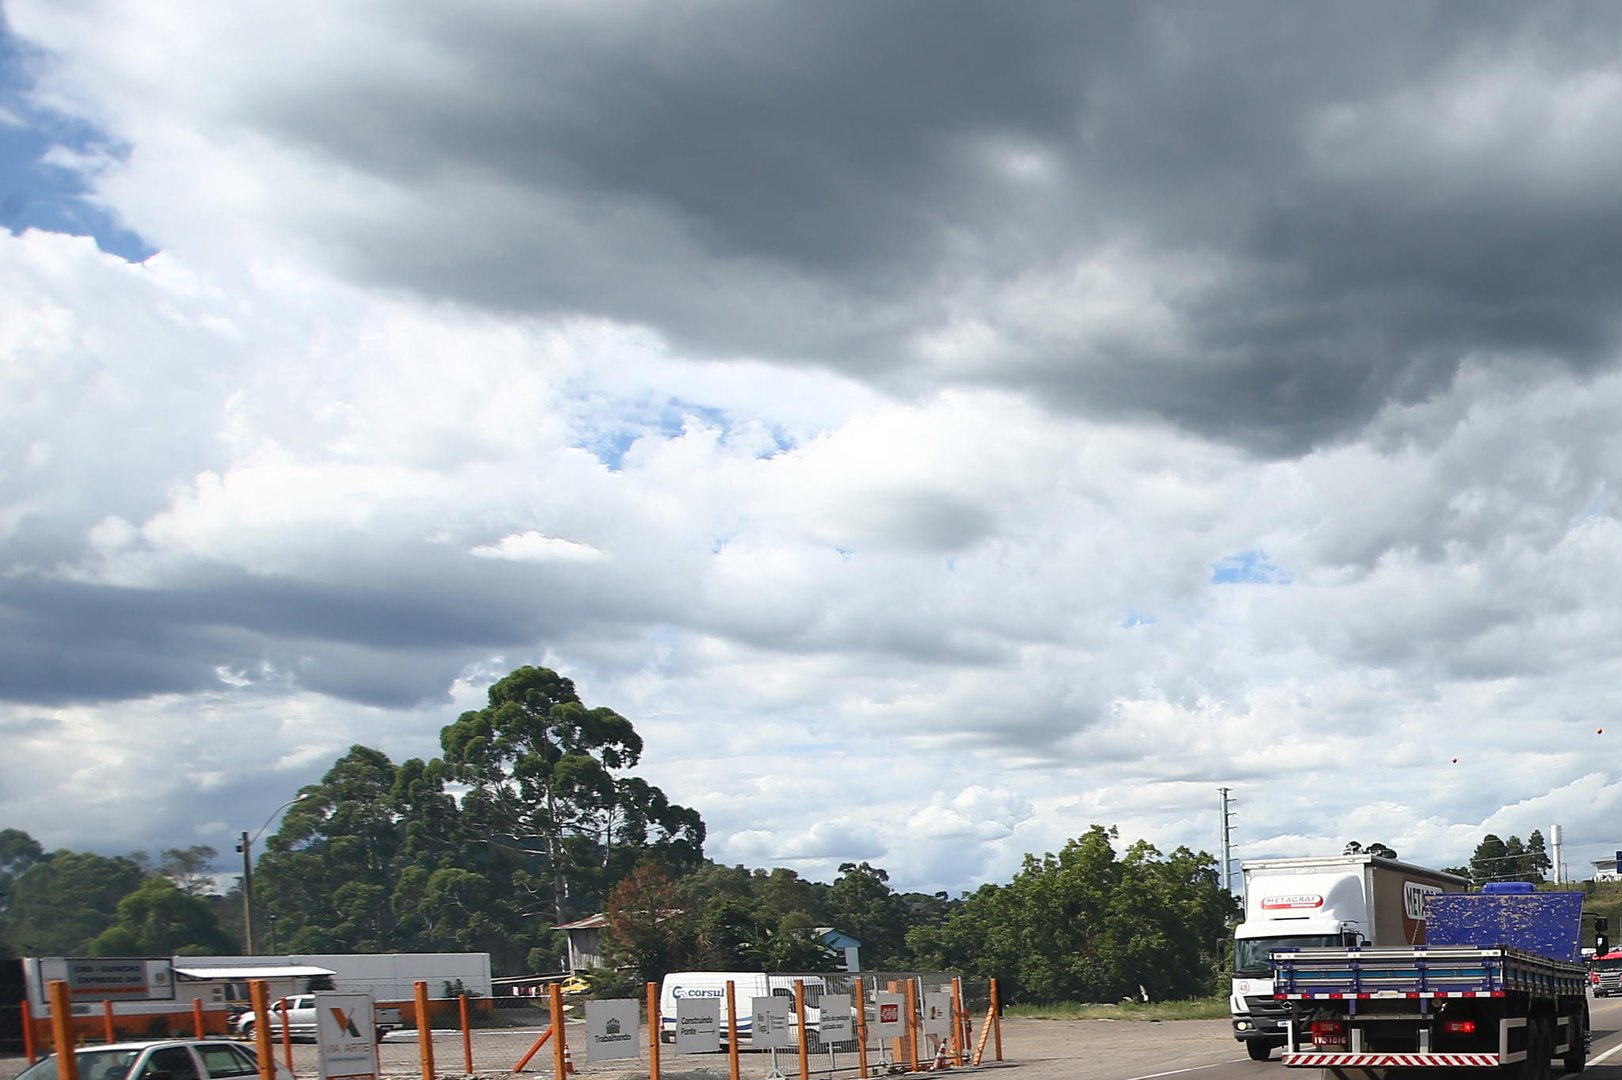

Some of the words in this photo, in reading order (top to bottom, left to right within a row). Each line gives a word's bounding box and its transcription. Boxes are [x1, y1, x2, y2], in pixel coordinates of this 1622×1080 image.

[1267, 896, 1316, 904] METAGRAF
[688, 987, 725, 997] corsul
[681, 1016, 713, 1025] Construindo
[595, 1034, 632, 1042] Trabalhando
[344, 1042, 370, 1052] ARTE
